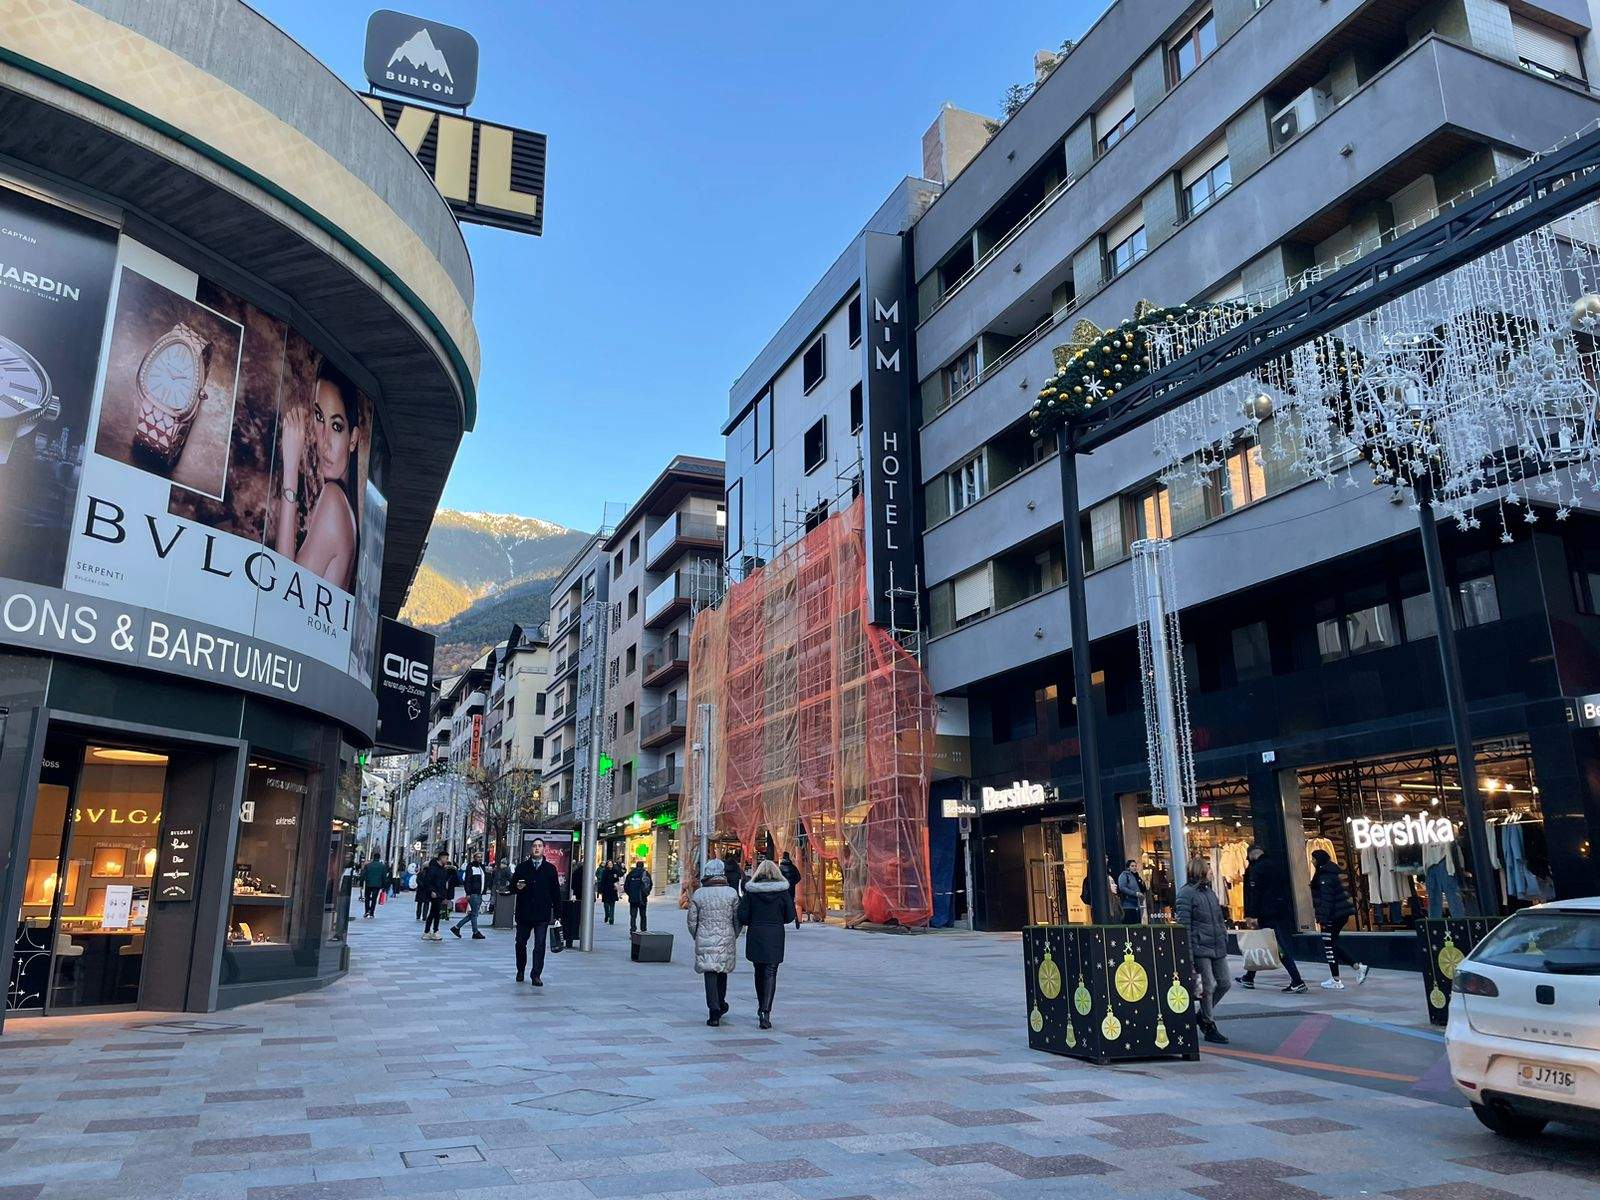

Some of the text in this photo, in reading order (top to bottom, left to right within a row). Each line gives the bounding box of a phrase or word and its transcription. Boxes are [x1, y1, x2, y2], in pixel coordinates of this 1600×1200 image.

[385, 70, 454, 95] BURTON
[1, 227, 37, 244] CAPTAIN
[874, 297, 900, 549] MIM HOTEL
[76, 561, 124, 581] SERPENTI
[81, 495, 351, 632] BVLGARI
[307, 617, 337, 638] ROMA
[3, 593, 302, 693] ONS & BARTUMEU
[1351, 810, 1455, 849] Bershka
[1535, 1068, 1572, 1087] J7136
